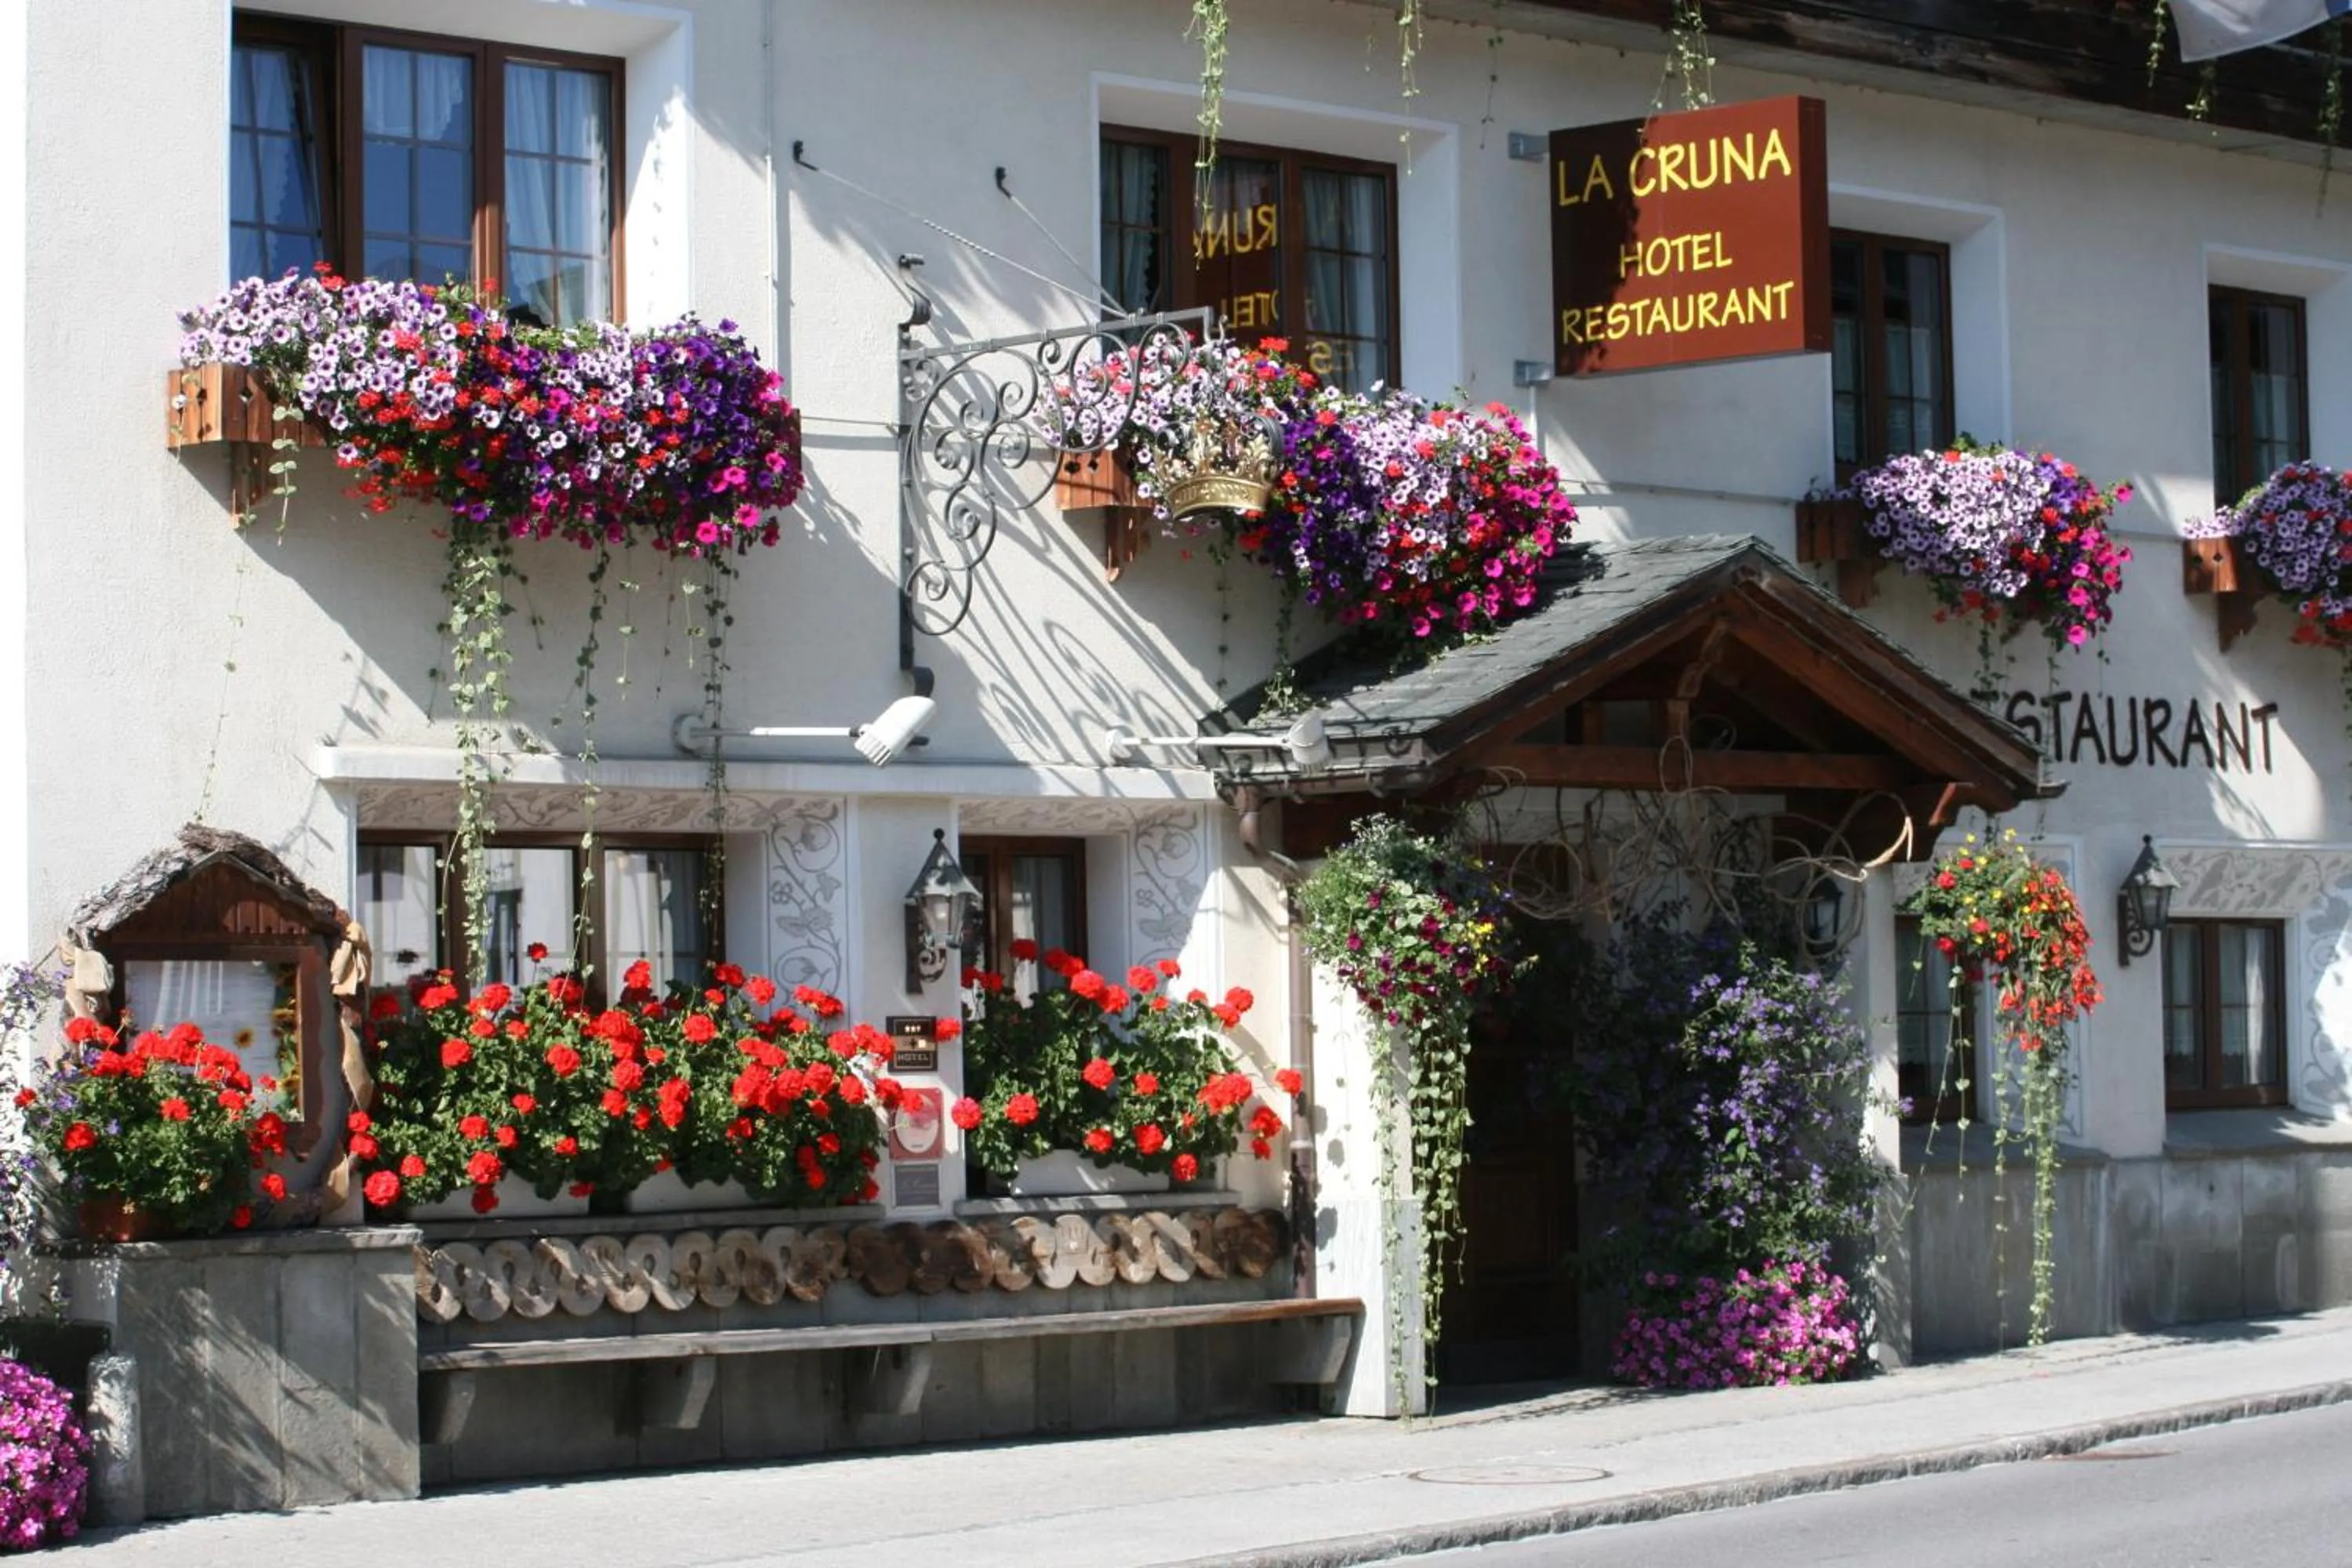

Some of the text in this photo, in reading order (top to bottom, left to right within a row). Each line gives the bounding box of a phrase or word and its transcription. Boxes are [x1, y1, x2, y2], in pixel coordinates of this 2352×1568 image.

[1558, 128, 1792, 206] LA CRUNA
[1619, 231, 1733, 278] HOTEL
[1562, 281, 1795, 345] RESTAURANT
[1970, 689, 2278, 775] STAURANT
[897, 1053, 929, 1062] HOTEL
